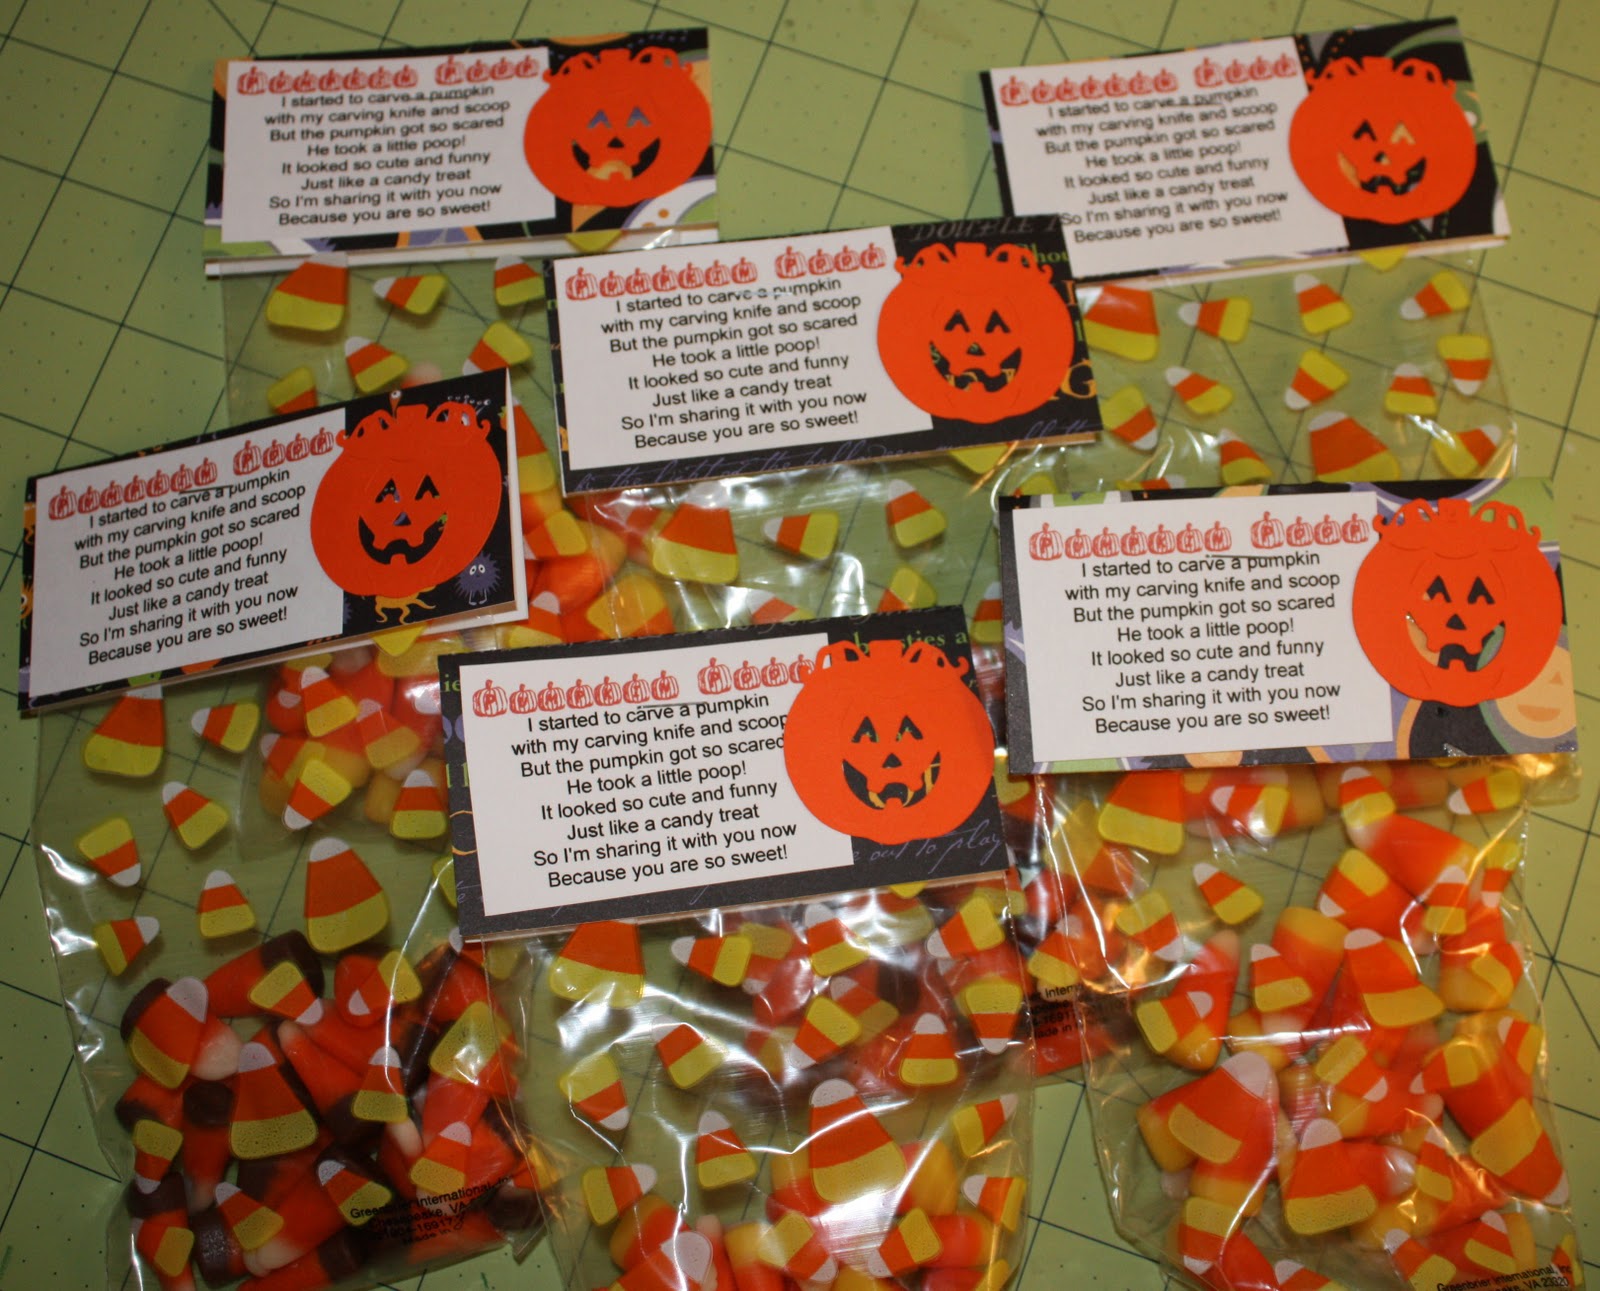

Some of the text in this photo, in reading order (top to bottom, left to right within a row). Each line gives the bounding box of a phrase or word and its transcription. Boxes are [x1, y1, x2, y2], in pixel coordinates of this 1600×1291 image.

[264, 101, 511, 125] with my carving knife and scoop
[1044, 119, 1276, 155] But the pumpkin got so scared
[281, 152, 491, 175] It looked so cute and funny
[1084, 142, 1241, 168] He took a little poop!
[1064, 158, 1270, 189] It looked so cute and funny
[268, 184, 502, 209] So I'm sharing it with you now
[609, 313, 858, 353] But the pumpkin got so scared
[652, 374, 832, 408] Just like a candy treat
[621, 392, 867, 431] So I'm sharing it with you now
[74, 485, 306, 551] with my carving knife and scoop
[91, 548, 288, 606] It looked so cute and funny
[1081, 551, 1320, 578] I started to carve a pumpkin
[79, 586, 299, 647] So I'm sharing it with you now
[1073, 593, 1335, 623] But the pumpkin got so scared
[698, 654, 814, 695] POO
[1082, 685, 1341, 712] So I'm sharing it with you now
[1095, 704, 1330, 734] Because you are so sweet!
[566, 760, 747, 795] He took a little poop!
[541, 782, 778, 820] It looked so cute and funny
[533, 824, 797, 867] So I'm sharing it with you now
[350, 1198, 415, 1220] Greener
